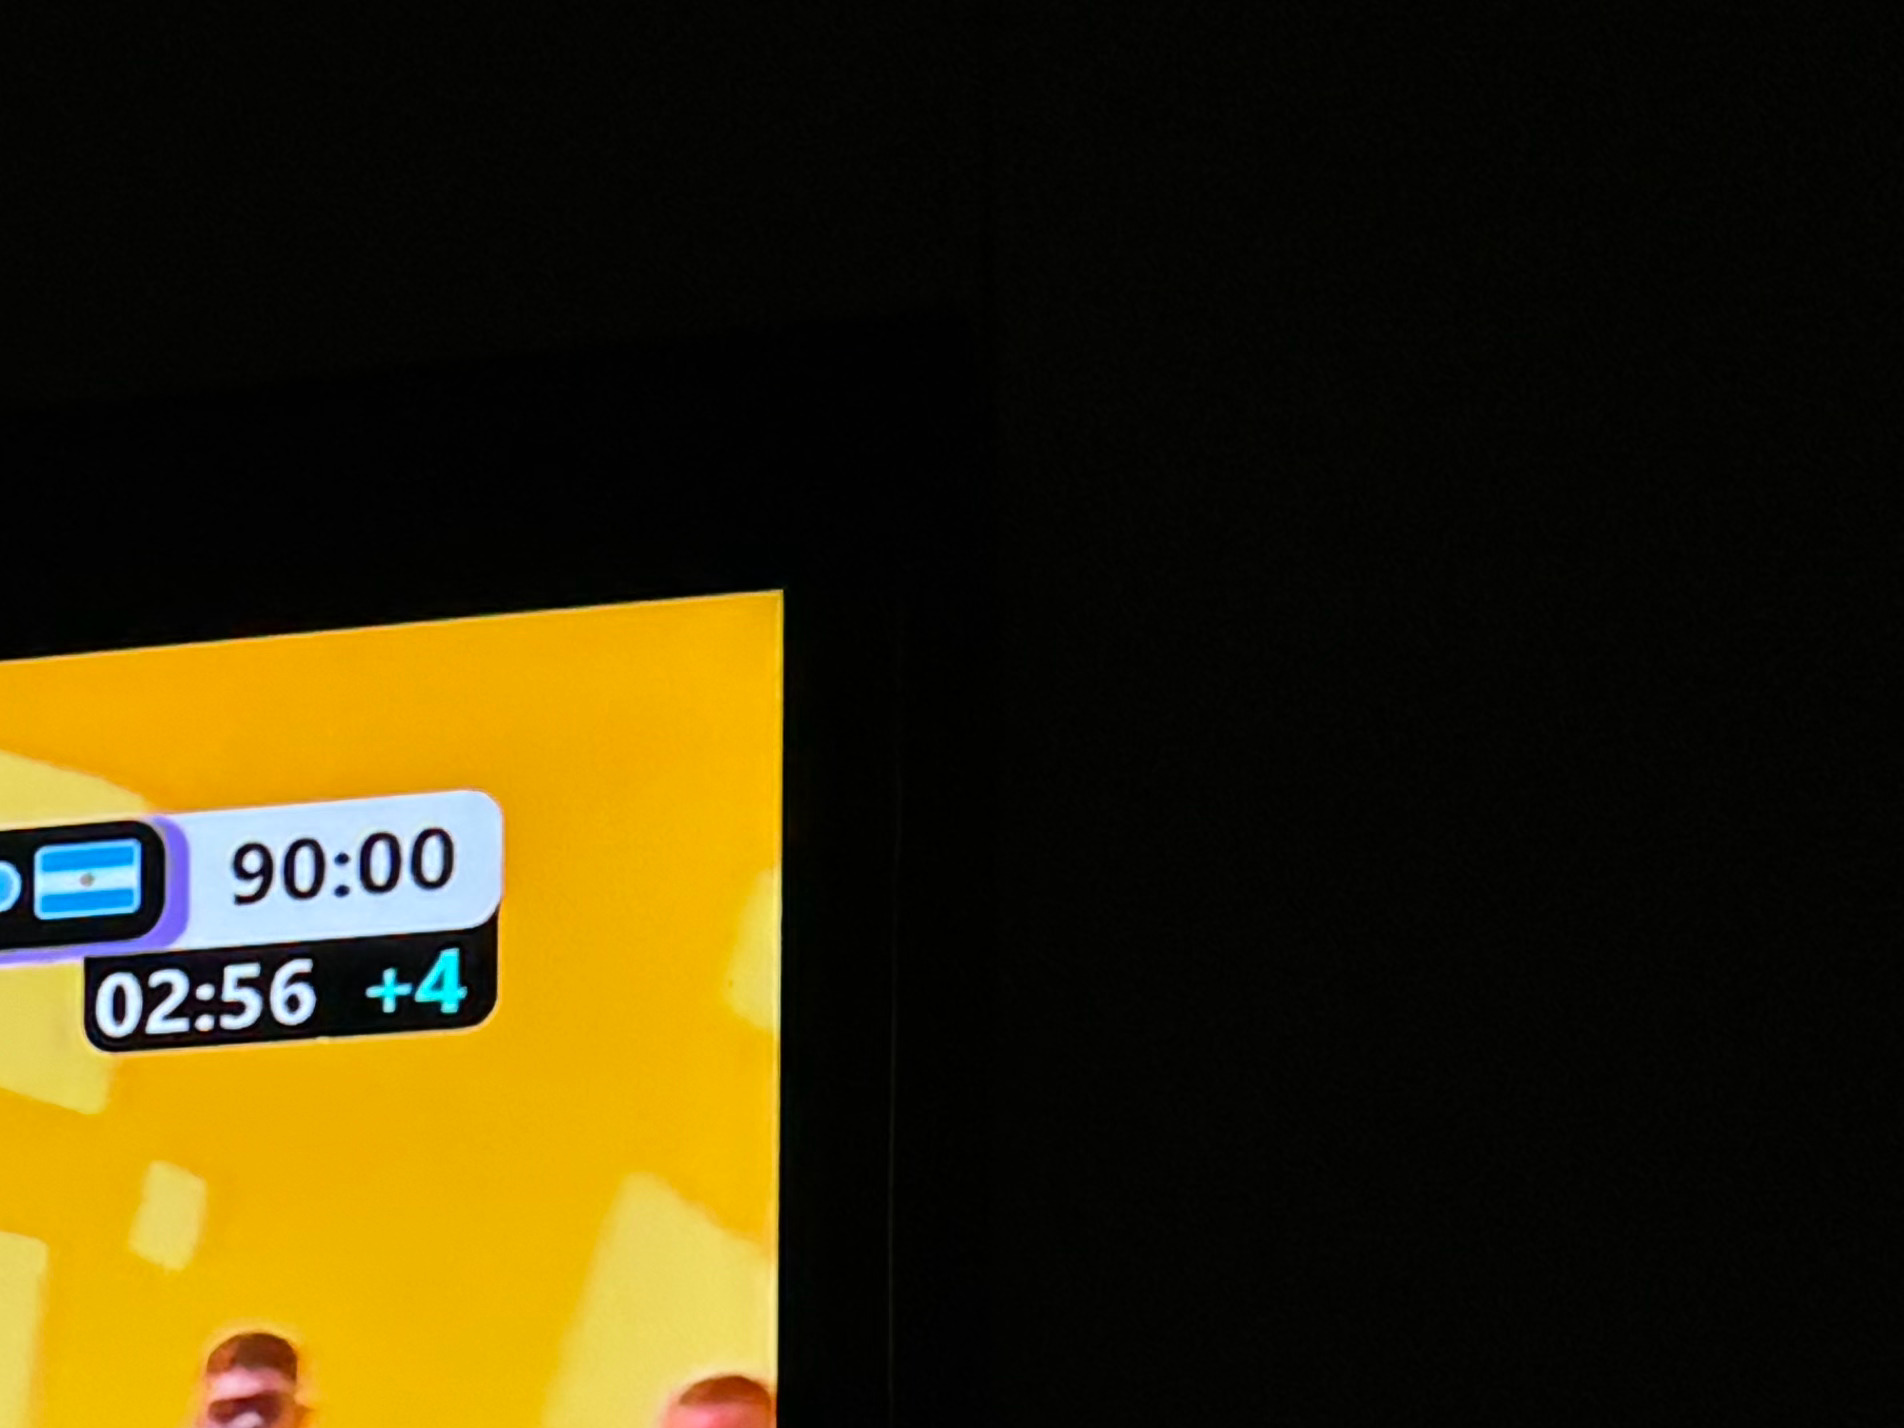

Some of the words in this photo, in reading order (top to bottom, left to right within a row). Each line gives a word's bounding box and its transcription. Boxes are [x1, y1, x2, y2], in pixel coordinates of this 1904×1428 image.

[231, 827, 455, 906] 90:00
[94, 958, 318, 1039] 02:56
[366, 948, 467, 1015] +4
